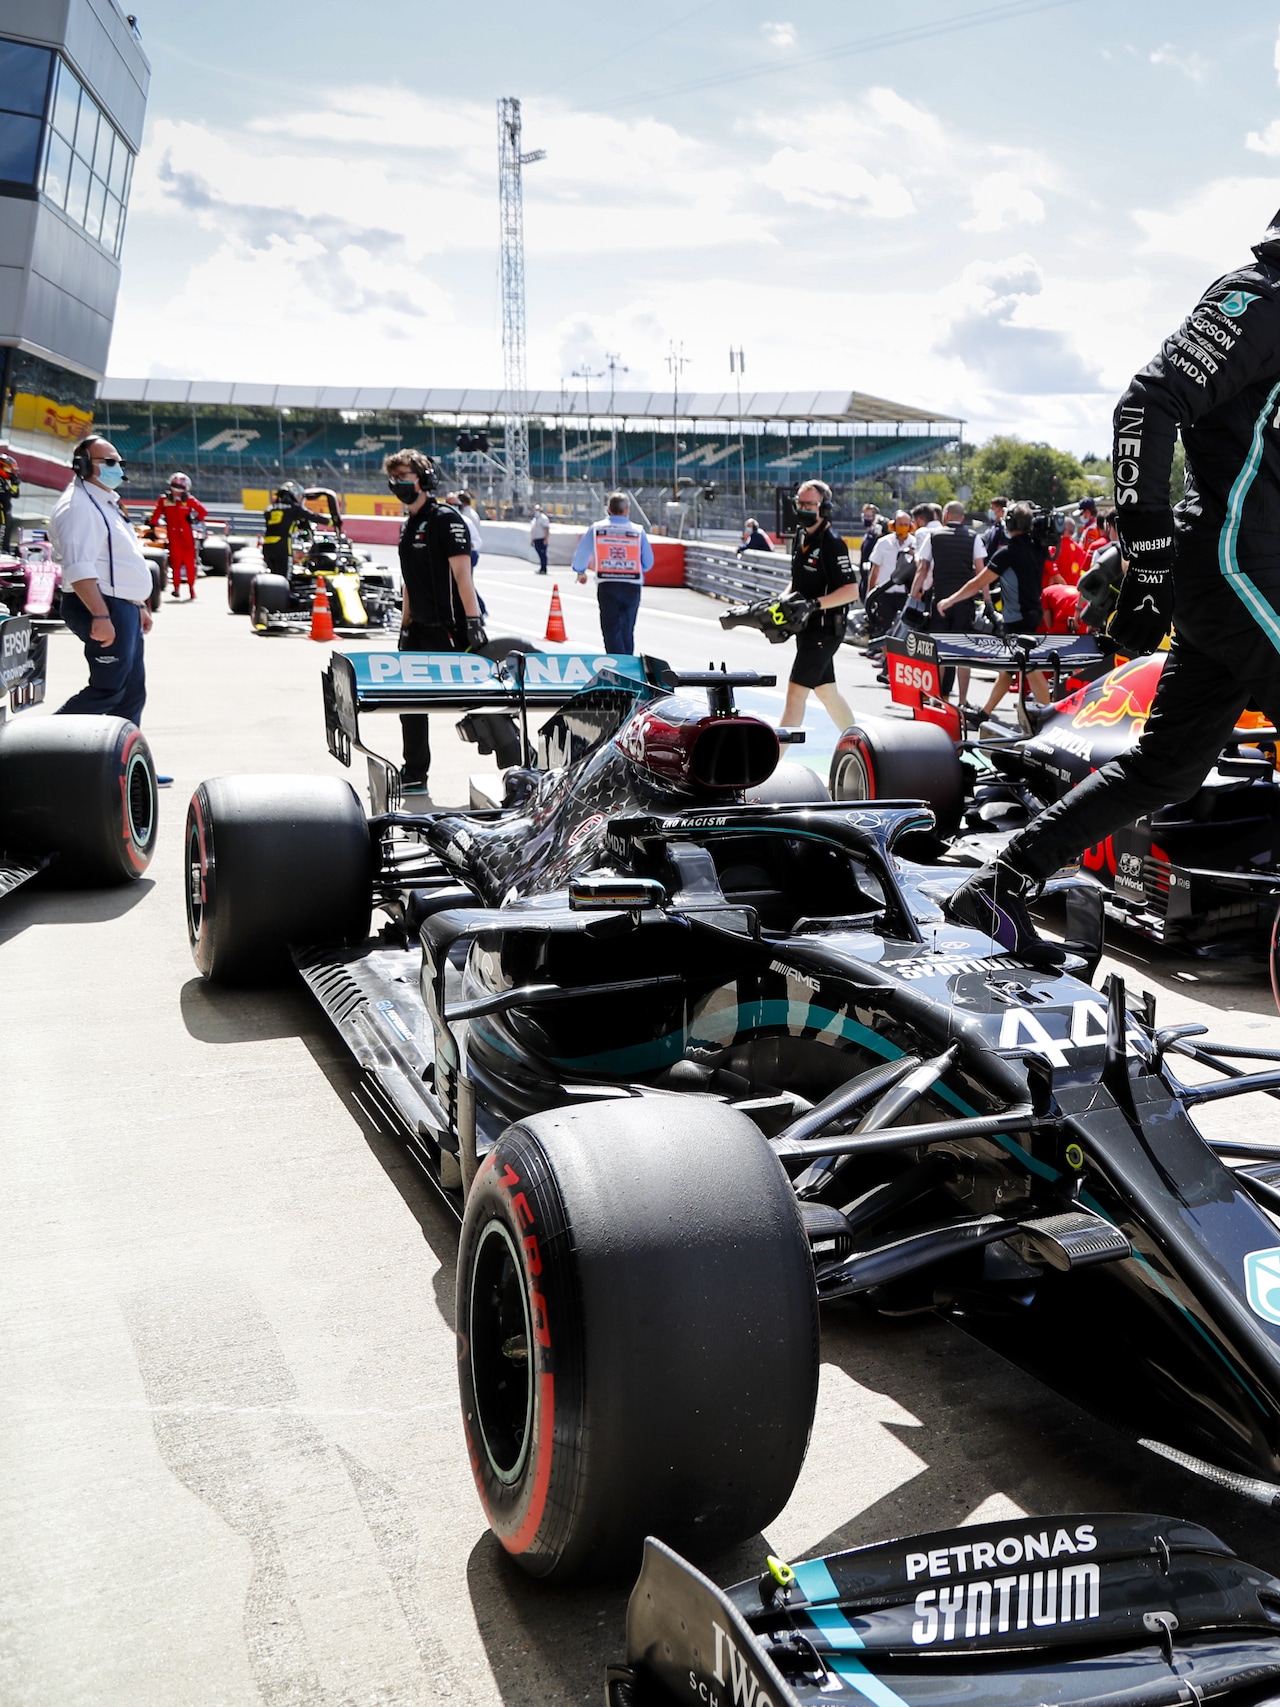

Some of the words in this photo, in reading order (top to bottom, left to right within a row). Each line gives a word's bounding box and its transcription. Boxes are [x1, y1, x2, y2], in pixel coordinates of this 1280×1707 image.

[1194, 317, 1236, 351] EPSON
[1168, 353, 1200, 378] AMD
[1177, 338, 1219, 374] PIRELLI
[1116, 405, 1145, 506] INEOS
[1132, 536, 1173, 551] #REFORM
[1137, 573, 1164, 584] IWC
[916, 642, 935, 656] AT&T
[368, 654, 620, 684] PETRNAS
[895, 661, 933, 692] ESSO
[681, 817, 728, 828] RACISM
[1114, 874, 1145, 892] myWorld
[786, 969, 821, 993] AMG
[998, 1000, 1145, 1068] 44
[497, 1163, 552, 1348] ZERO
[905, 1524, 1099, 1582] PETRONAS
[911, 1562, 1101, 1646] SYNTIUM
